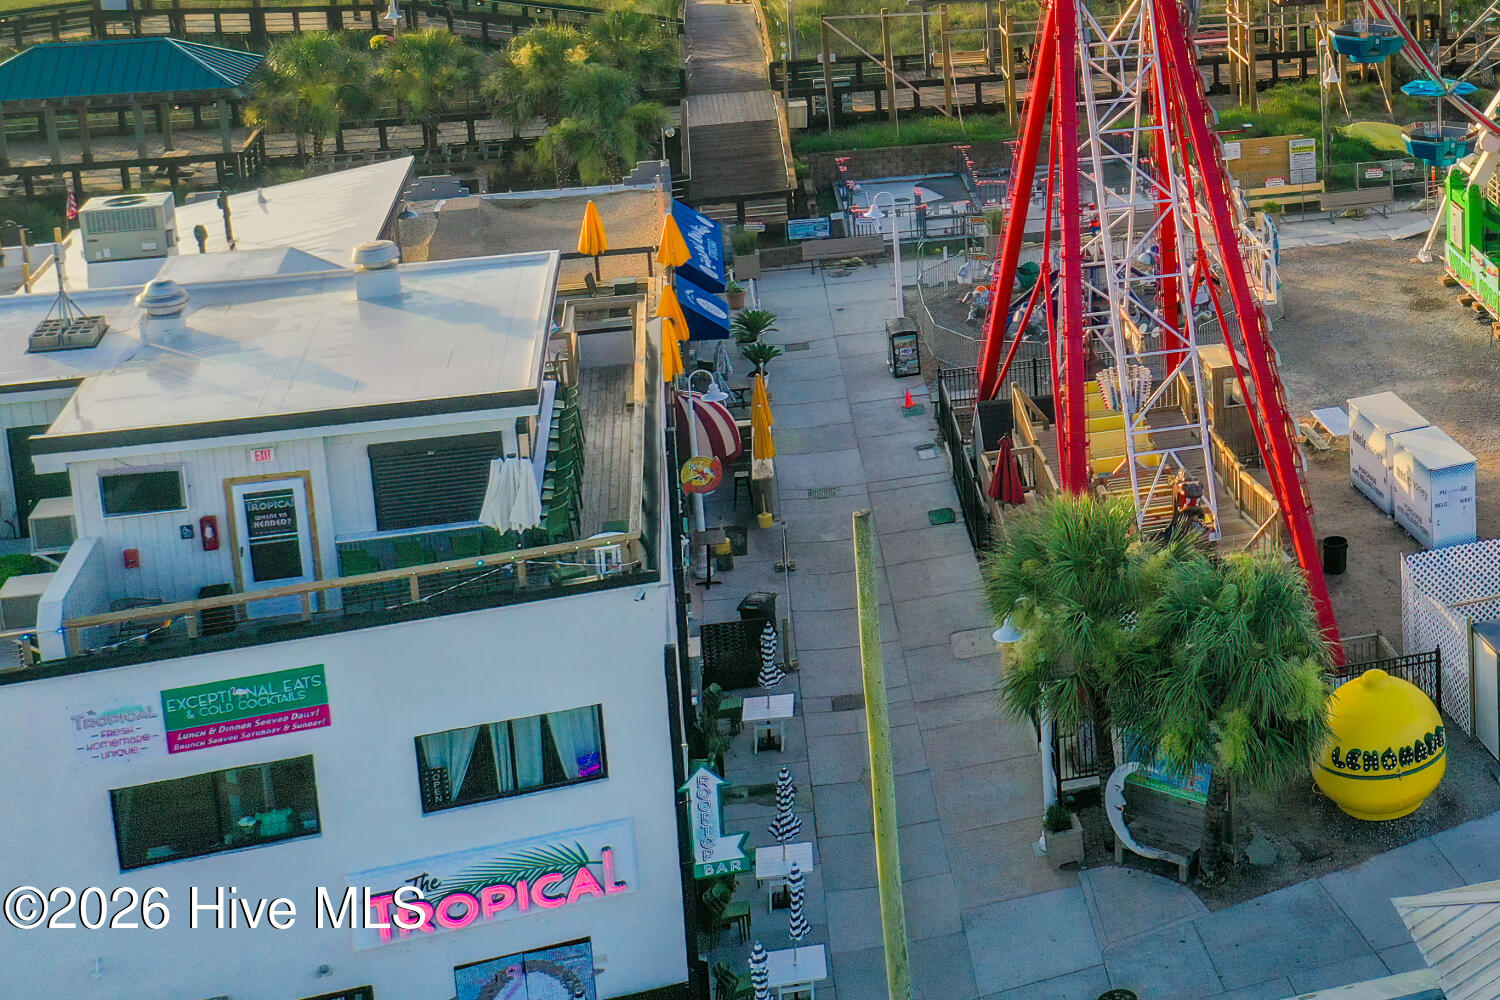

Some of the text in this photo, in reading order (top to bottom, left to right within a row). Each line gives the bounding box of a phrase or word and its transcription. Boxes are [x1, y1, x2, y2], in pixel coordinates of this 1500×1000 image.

[255, 449, 272, 461] EXIT
[167, 675, 322, 713] EXCEPTINAL EATS
[186, 690, 306, 719] & COLD COCKTAILS
[208, 726, 216, 736] &
[283, 724, 290, 732] &
[431, 773, 443, 803] OPEN
[696, 775, 714, 862] ROOFTOP
[703, 860, 742, 876] BAR
[369, 846, 628, 943] TROPICAL
[405, 872, 441, 893] The
